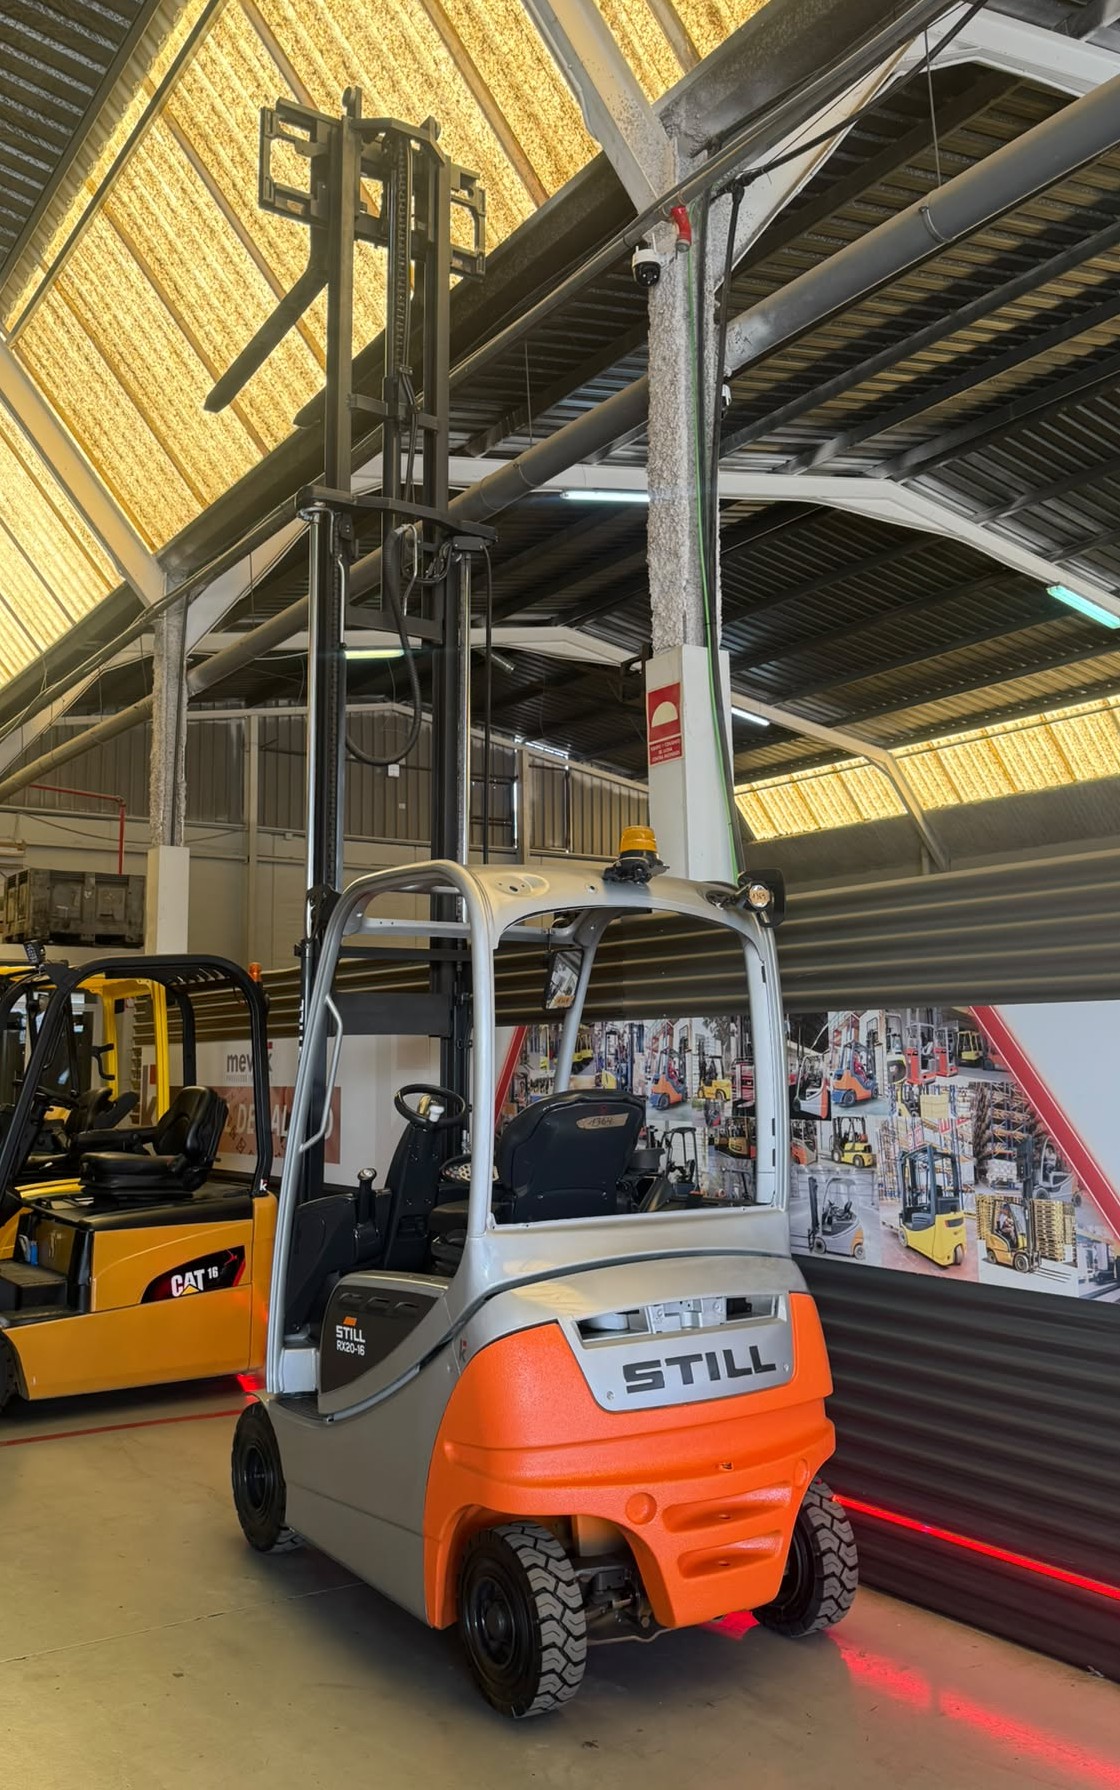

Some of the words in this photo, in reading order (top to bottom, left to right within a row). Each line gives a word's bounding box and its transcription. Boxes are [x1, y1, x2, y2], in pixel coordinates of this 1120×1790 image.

[171, 1268, 205, 1297] CAT
[207, 1266, 219, 1279] 16
[335, 1325, 366, 1343] STILL
[336, 1339, 366, 1356] RX20-16
[622, 1345, 777, 1394] STILL
